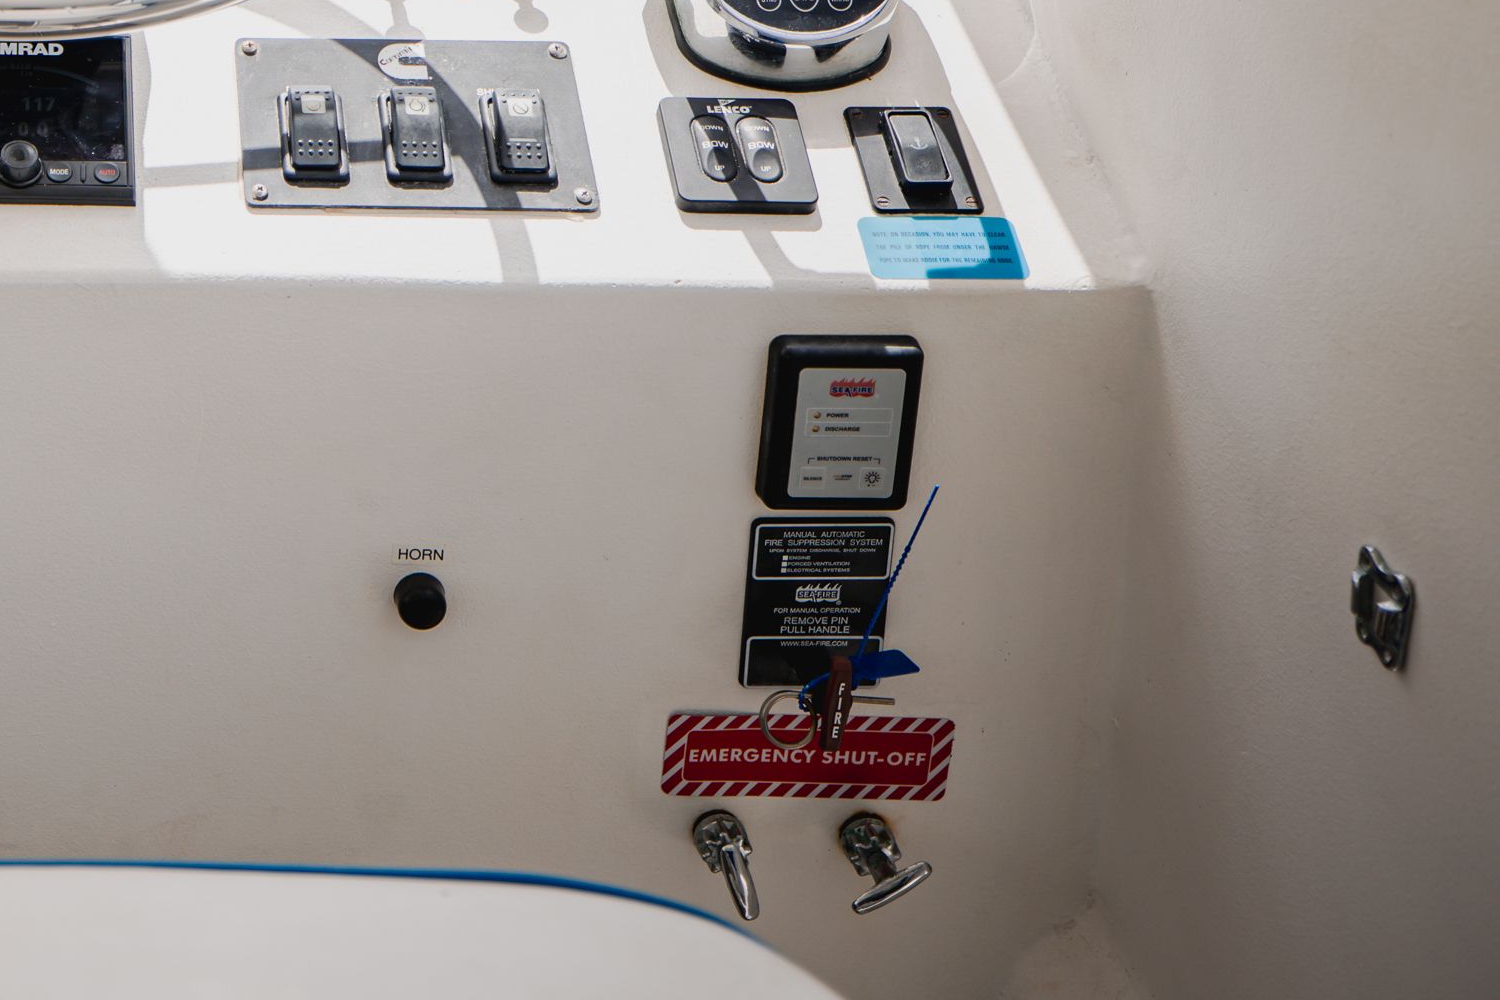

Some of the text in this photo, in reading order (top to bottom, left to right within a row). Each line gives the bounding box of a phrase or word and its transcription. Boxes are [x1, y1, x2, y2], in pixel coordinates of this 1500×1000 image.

[706, 105, 751, 114] LENCO
[702, 140, 729, 149] BOW
[783, 531, 865, 539] MANUAL AUTOMATIC
[764, 539, 883, 547] FIRE SUPPRESSION SYSTEM
[398, 548, 444, 561] HORN
[798, 591, 837, 599] SEA-FIRE
[784, 617, 849, 625] REMOVE PIN
[780, 626, 850, 634] PULL HANDLE
[832, 682, 846, 739] FIRE
[689, 749, 926, 767] EMERGENCY SHUT-OFF
